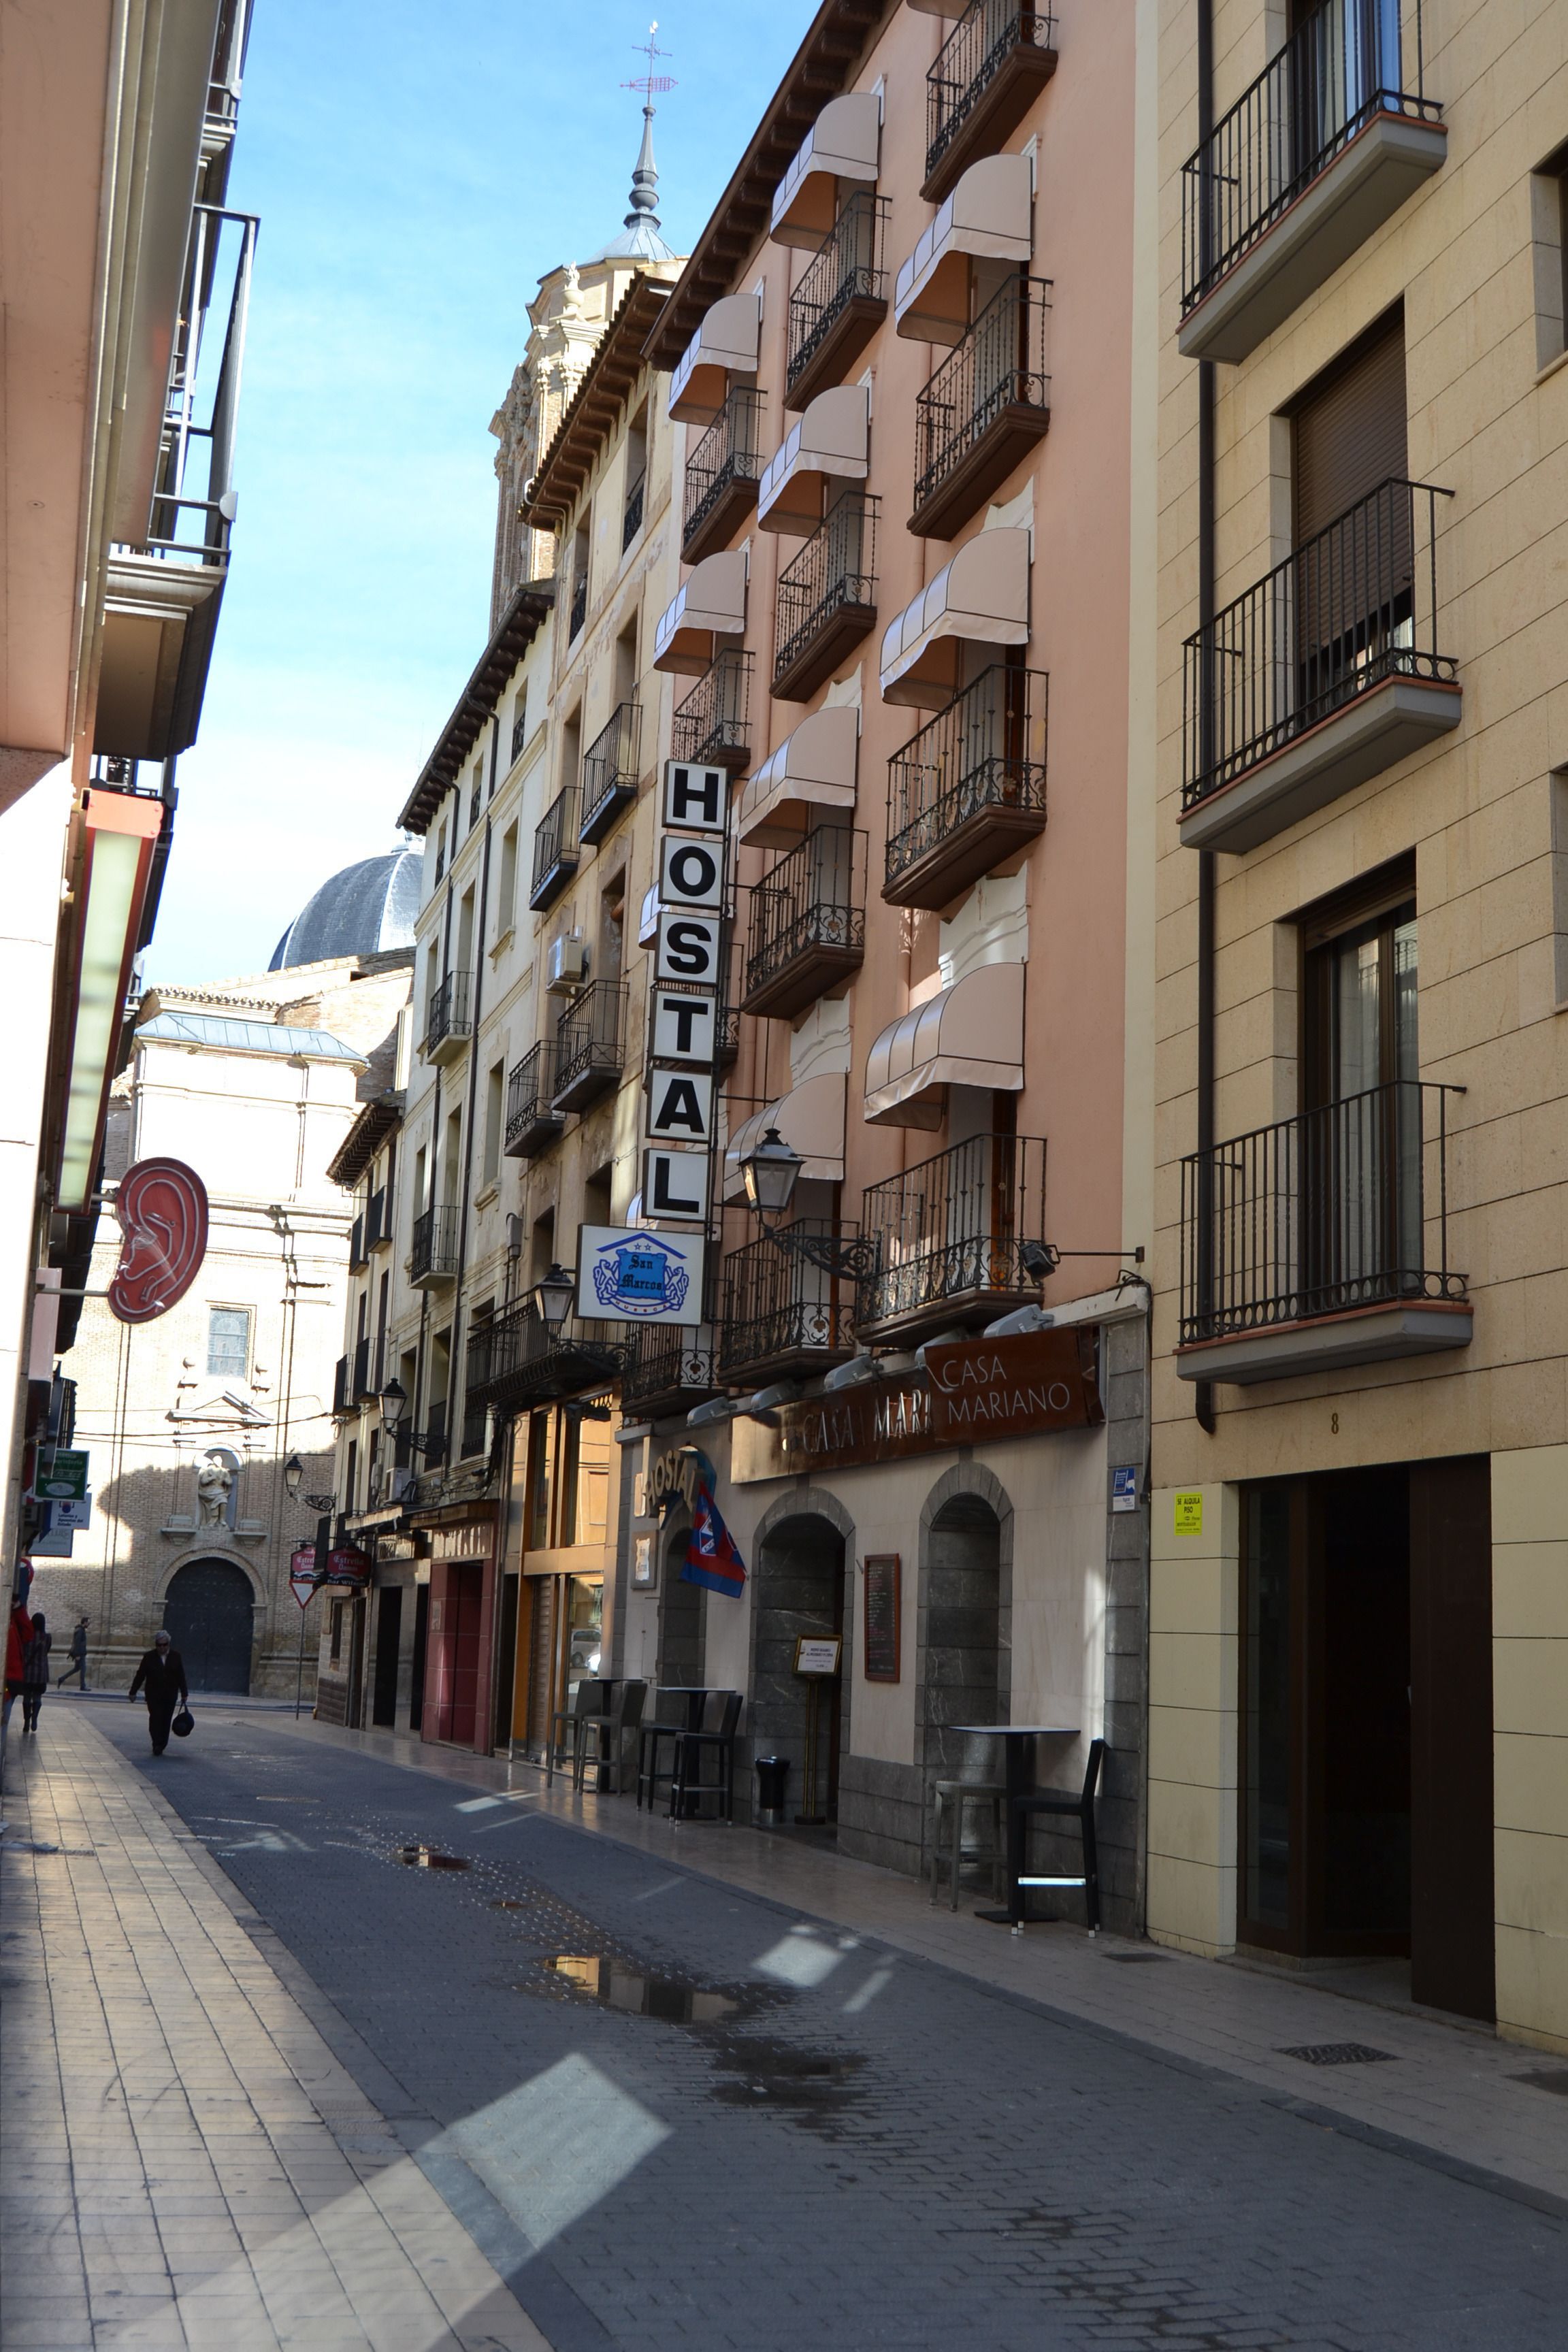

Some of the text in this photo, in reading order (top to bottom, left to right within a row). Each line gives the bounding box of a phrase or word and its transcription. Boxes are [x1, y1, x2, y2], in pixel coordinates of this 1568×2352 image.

[654, 768, 717, 1213] HOSTAL
[628, 1254, 653, 1270] San
[619, 1274, 662, 1290] Marcos
[615, 1300, 668, 1313] HUESCA
[942, 1355, 1007, 1388] CASA
[948, 1382, 1071, 1424] MARIANO
[802, 1389, 932, 1454] CASA MARI
[1331, 1412, 1339, 1435] 8
[646, 1449, 696, 1514] HOSTAL
[1184, 1497, 1200, 1505] ALQUILA
[333, 1554, 365, 1565] Estrella
